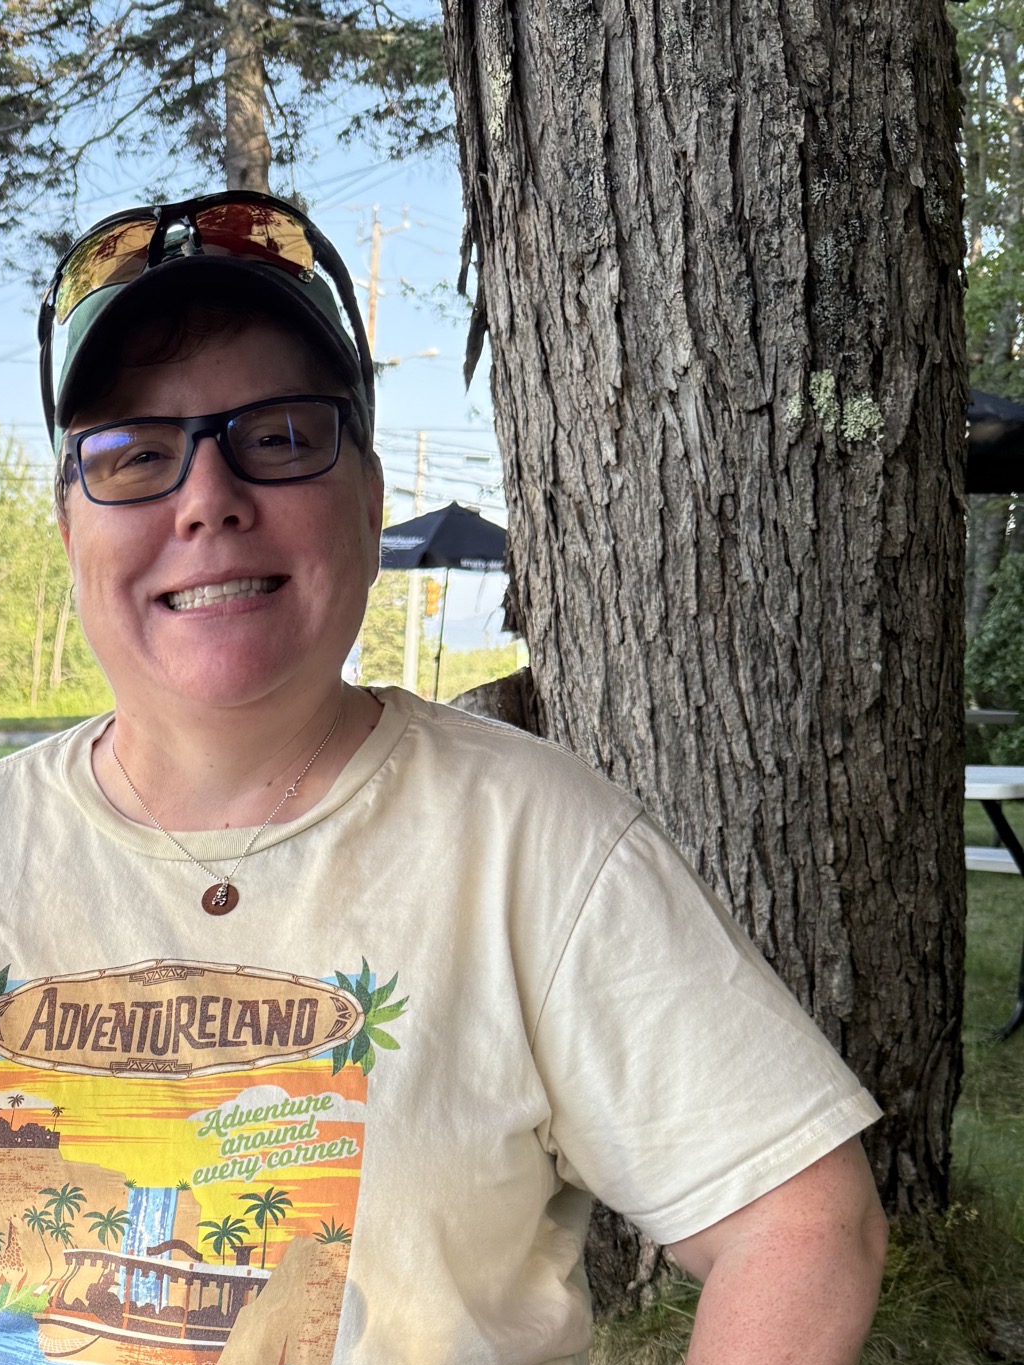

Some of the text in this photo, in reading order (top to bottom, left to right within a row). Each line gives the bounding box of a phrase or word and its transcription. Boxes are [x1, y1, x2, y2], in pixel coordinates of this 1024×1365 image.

[19, 986, 319, 1056] ADVENTURELAND
[197, 1094, 334, 1137] Adventure
[220, 1114, 317, 1155] around
[192, 1137, 358, 1186] every corner
